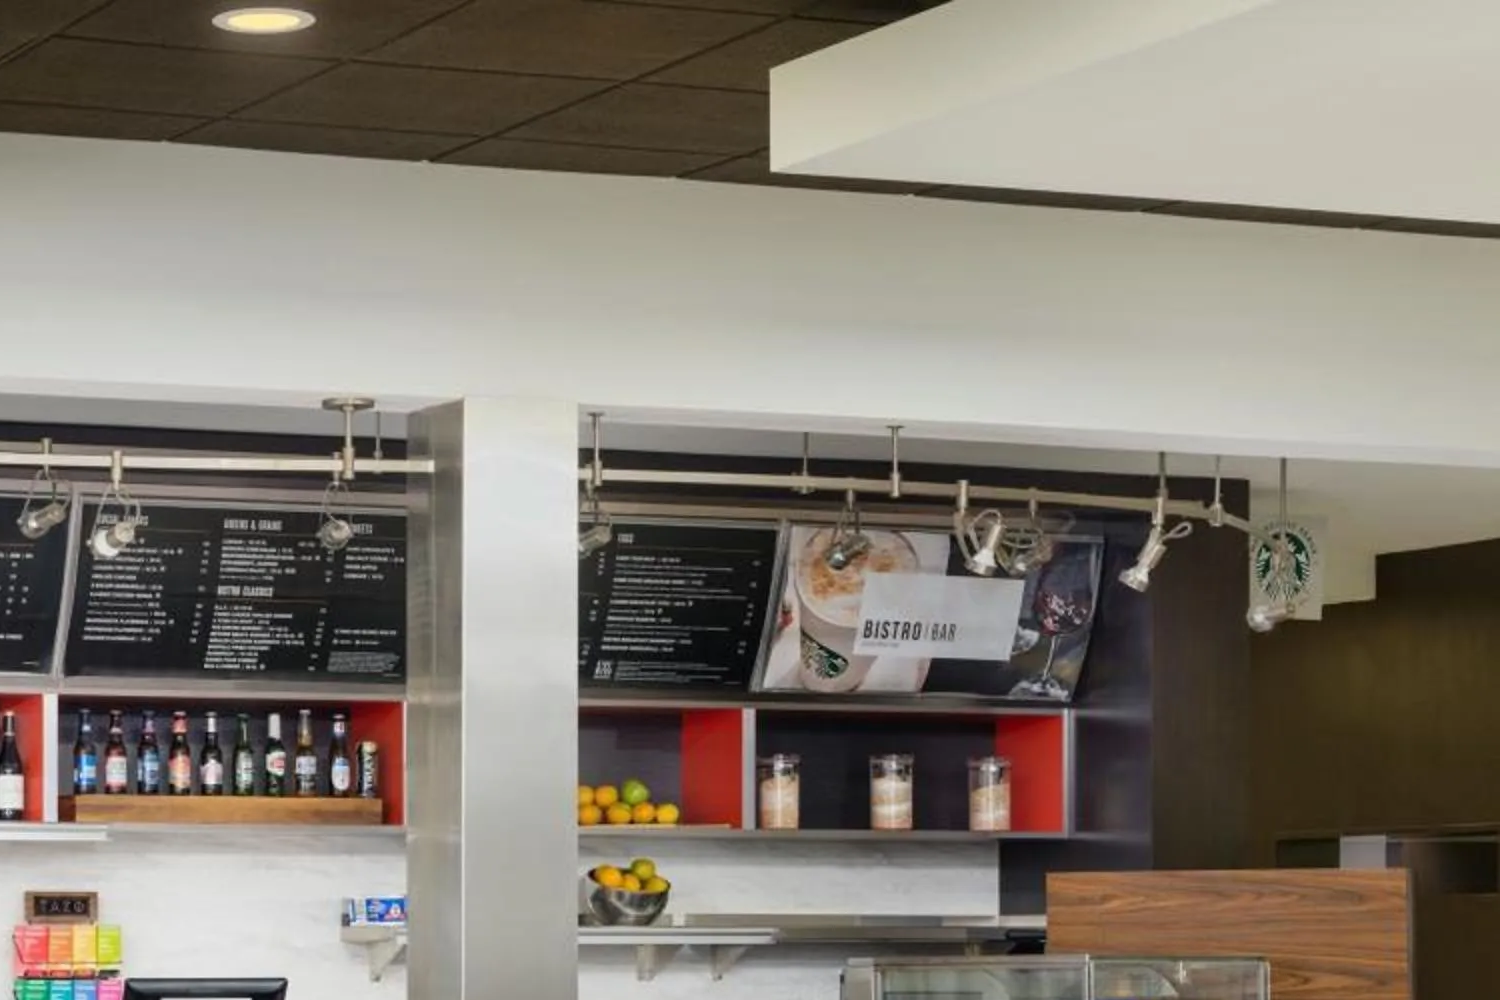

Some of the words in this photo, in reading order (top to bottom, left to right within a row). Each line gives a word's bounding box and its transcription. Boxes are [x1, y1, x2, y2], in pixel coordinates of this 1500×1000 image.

[863, 619, 923, 641] BISTRO
[930, 622, 958, 642] BAR
[40, 900, 85, 914] TAZO
